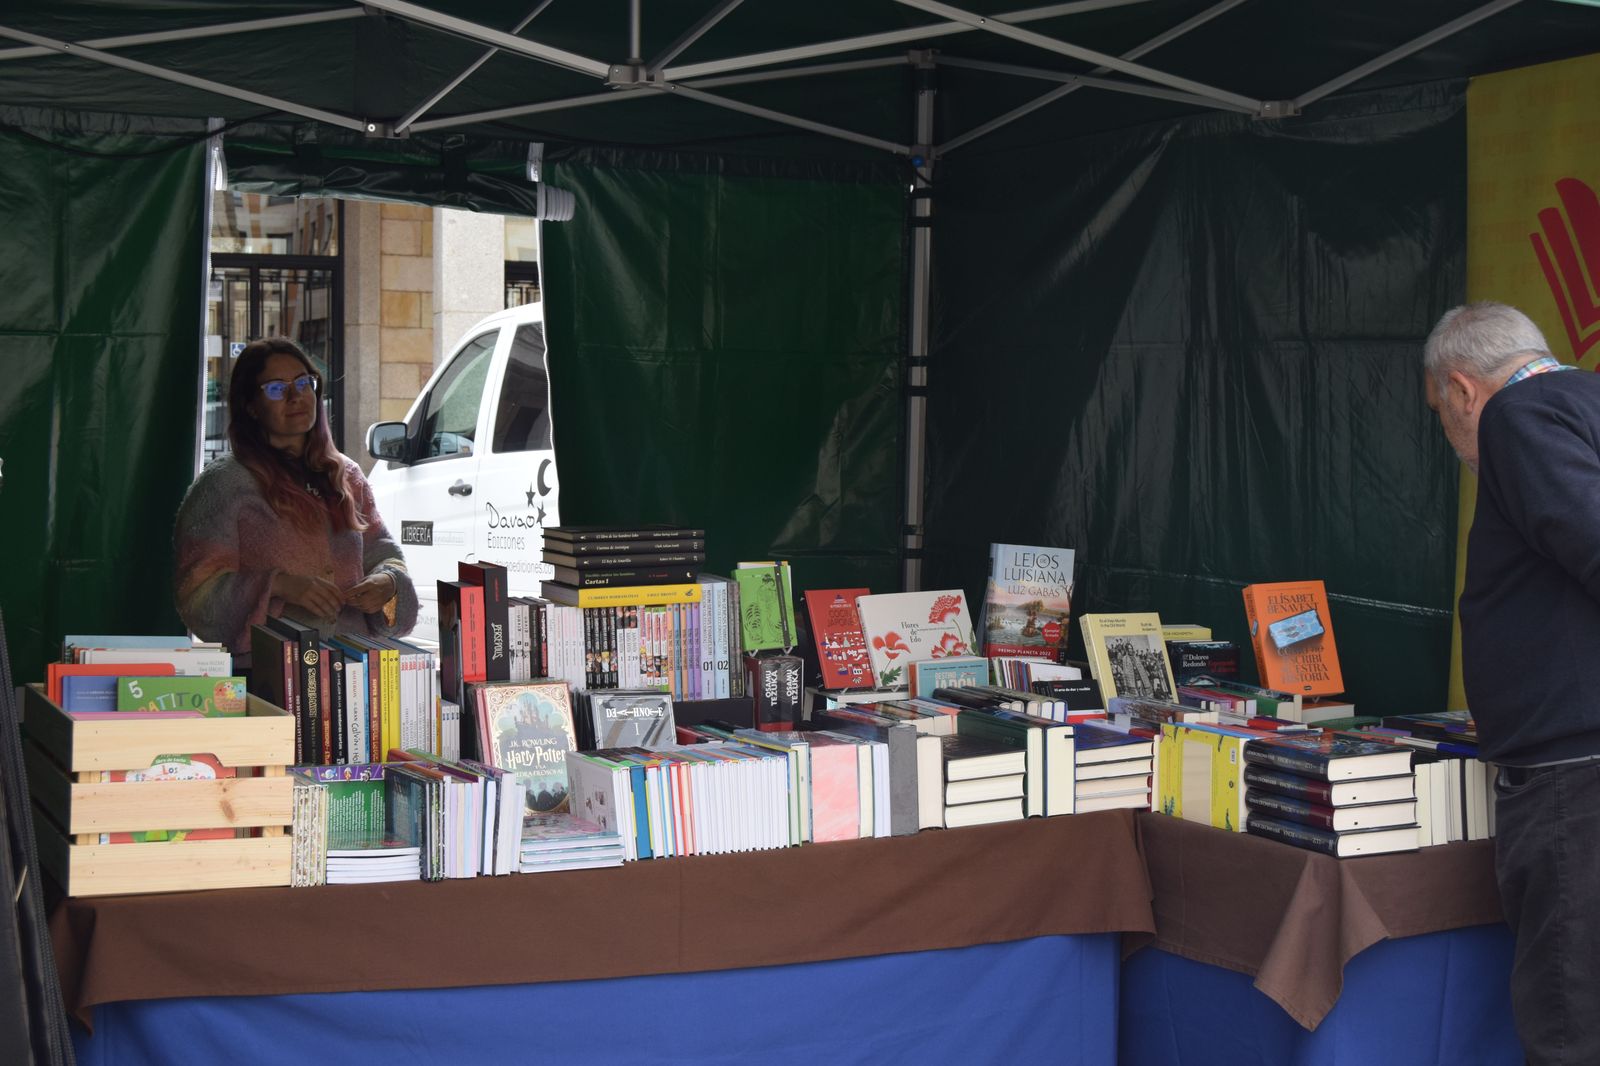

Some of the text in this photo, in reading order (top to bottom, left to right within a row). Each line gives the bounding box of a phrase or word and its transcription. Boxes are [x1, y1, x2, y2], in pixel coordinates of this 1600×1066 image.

[486, 502, 535, 529] Davao
[402, 525, 431, 542] LIBRERÍA
[1014, 552, 1060, 570] LEJOS
[1004, 568, 1067, 584] LUISIANA
[1008, 586, 1026, 595] LUZ
[1267, 592, 1315, 604] ELÍSABET
[1268, 602, 1320, 614] BENAVENT
[910, 635, 922, 643] Edo
[703, 662, 713, 671] 01
[717, 660, 729, 670] 02
[128, 680, 143, 698] 5
[352, 722, 361, 745] Calvin
[522, 736, 558, 747] ROWLING
[506, 746, 566, 770] Harry Potter
[162, 765, 178, 774] Los
